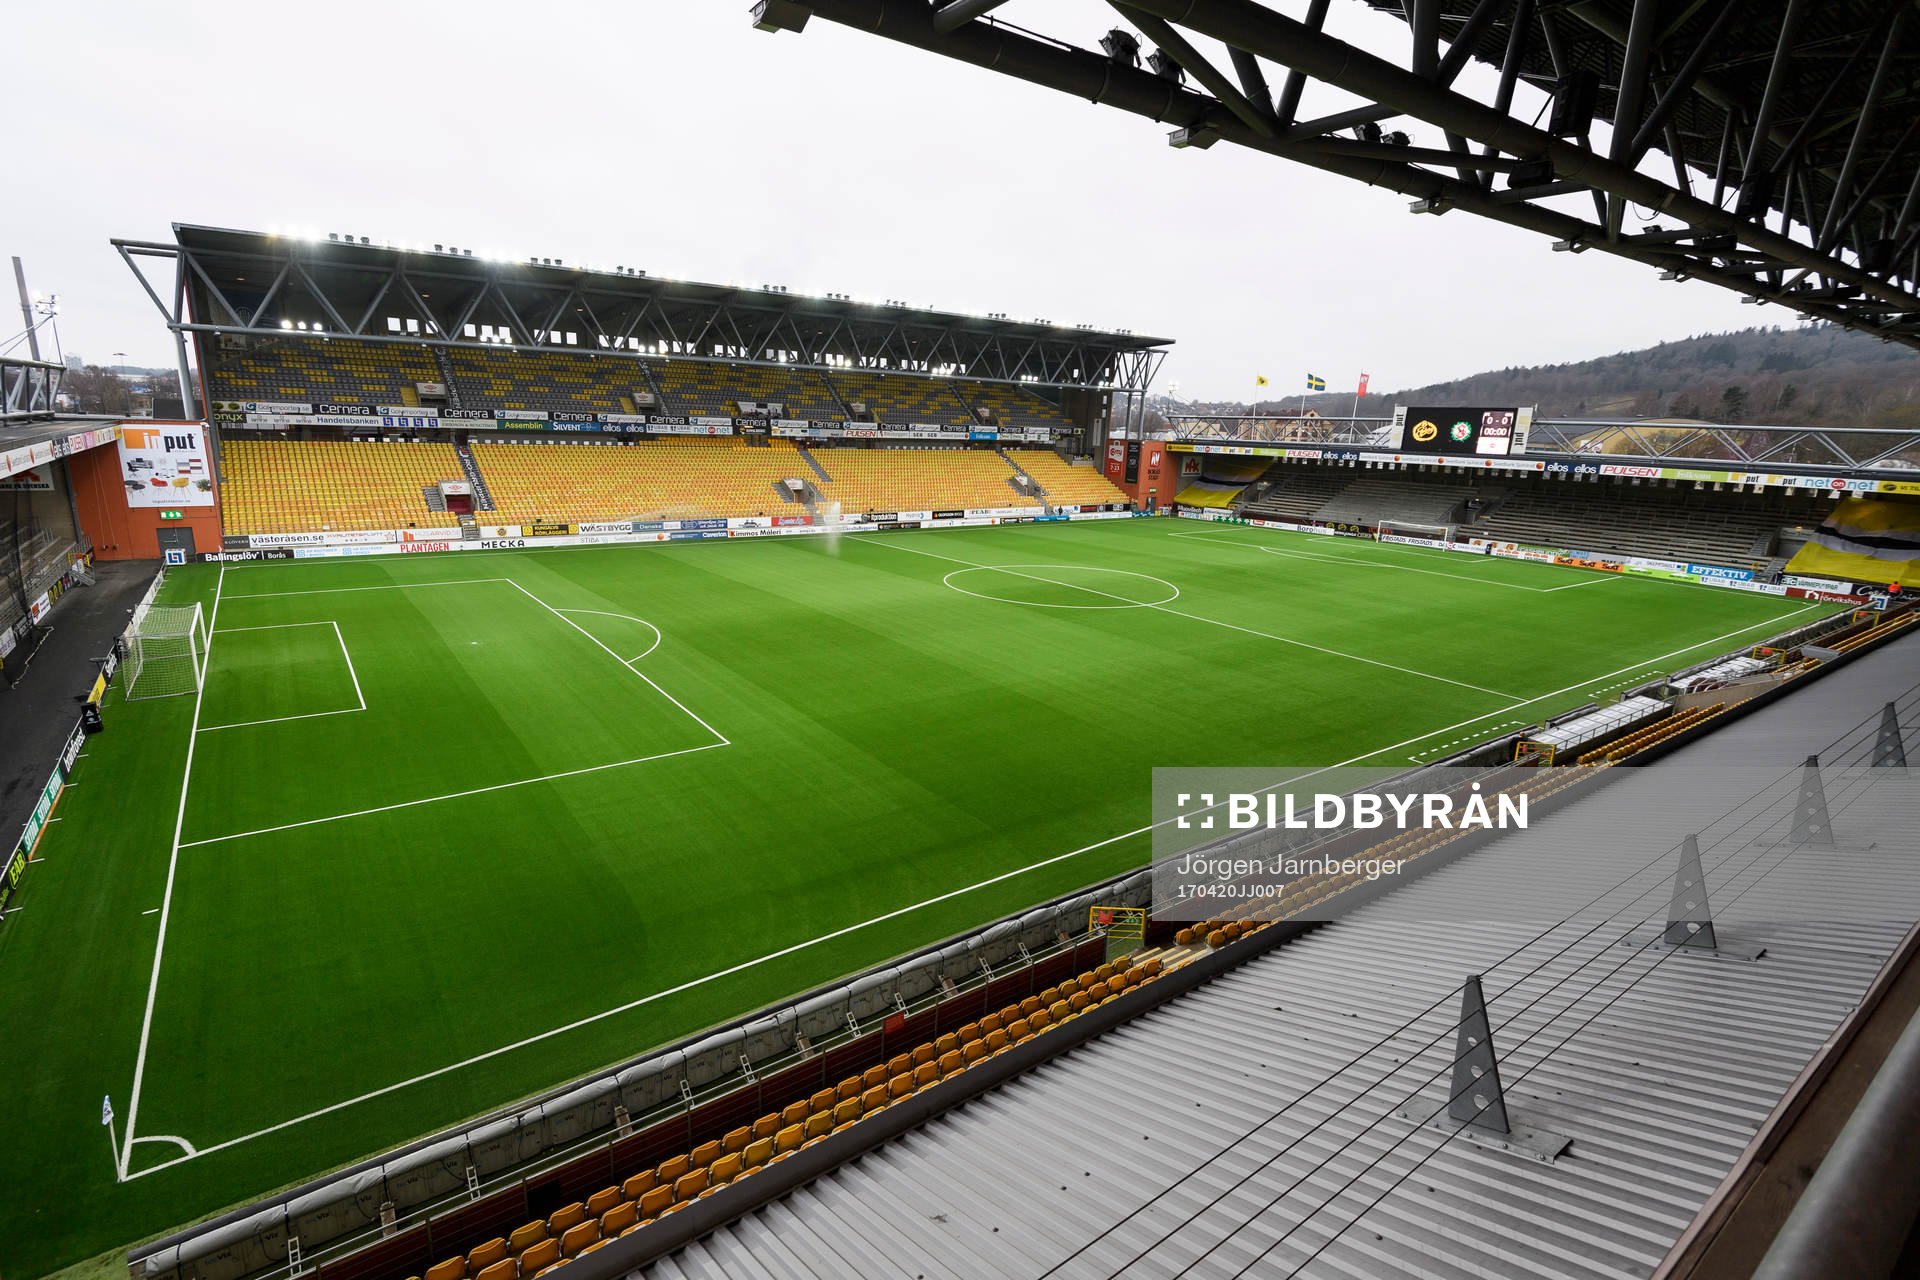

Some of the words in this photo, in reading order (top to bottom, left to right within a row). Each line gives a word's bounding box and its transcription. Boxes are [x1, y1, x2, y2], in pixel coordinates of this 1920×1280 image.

[319, 404, 370, 415] Cernera
[444, 409, 489, 419] Cernera
[316, 416, 379, 425] Handelsbanken
[553, 411, 593, 421] Cernera
[650, 415, 685, 425] Cernera
[1486, 416, 1493, 425] 0
[1501, 416, 1508, 425] 0
[504, 422, 544, 430] Assemblin
[735, 418, 767, 427] Cernera
[812, 421, 840, 429] Cernera
[880, 423, 907, 431] Cernera
[602, 423, 622, 432] ellos
[626, 424, 645, 433] ellos
[1483, 427, 1507, 436] 00:00
[845, 430, 877, 438] PULSEN
[1287, 450, 1321, 458] PULSEN
[1323, 452, 1339, 460] ellos
[1341, 452, 1358, 460] ellos
[1547, 462, 1569, 472] ellos
[1574, 463, 1596, 474] ellos
[1602, 466, 1658, 477] PULSEN
[702, 531, 727, 539] Caverion
[481, 540, 525, 549] MECKA
[1382, 535, 1406, 543] FRISTADS
[1408, 538, 1433, 546] FRISTADS
[400, 542, 450, 553] PLANTAGEN
[204, 551, 259, 562] Ballingslöv
[267, 552, 287, 560] Borås
[1691, 565, 1748, 580] EFFEKTIV
[62, 726, 86, 774] brainforest
[10, 851, 26, 884] EAB
